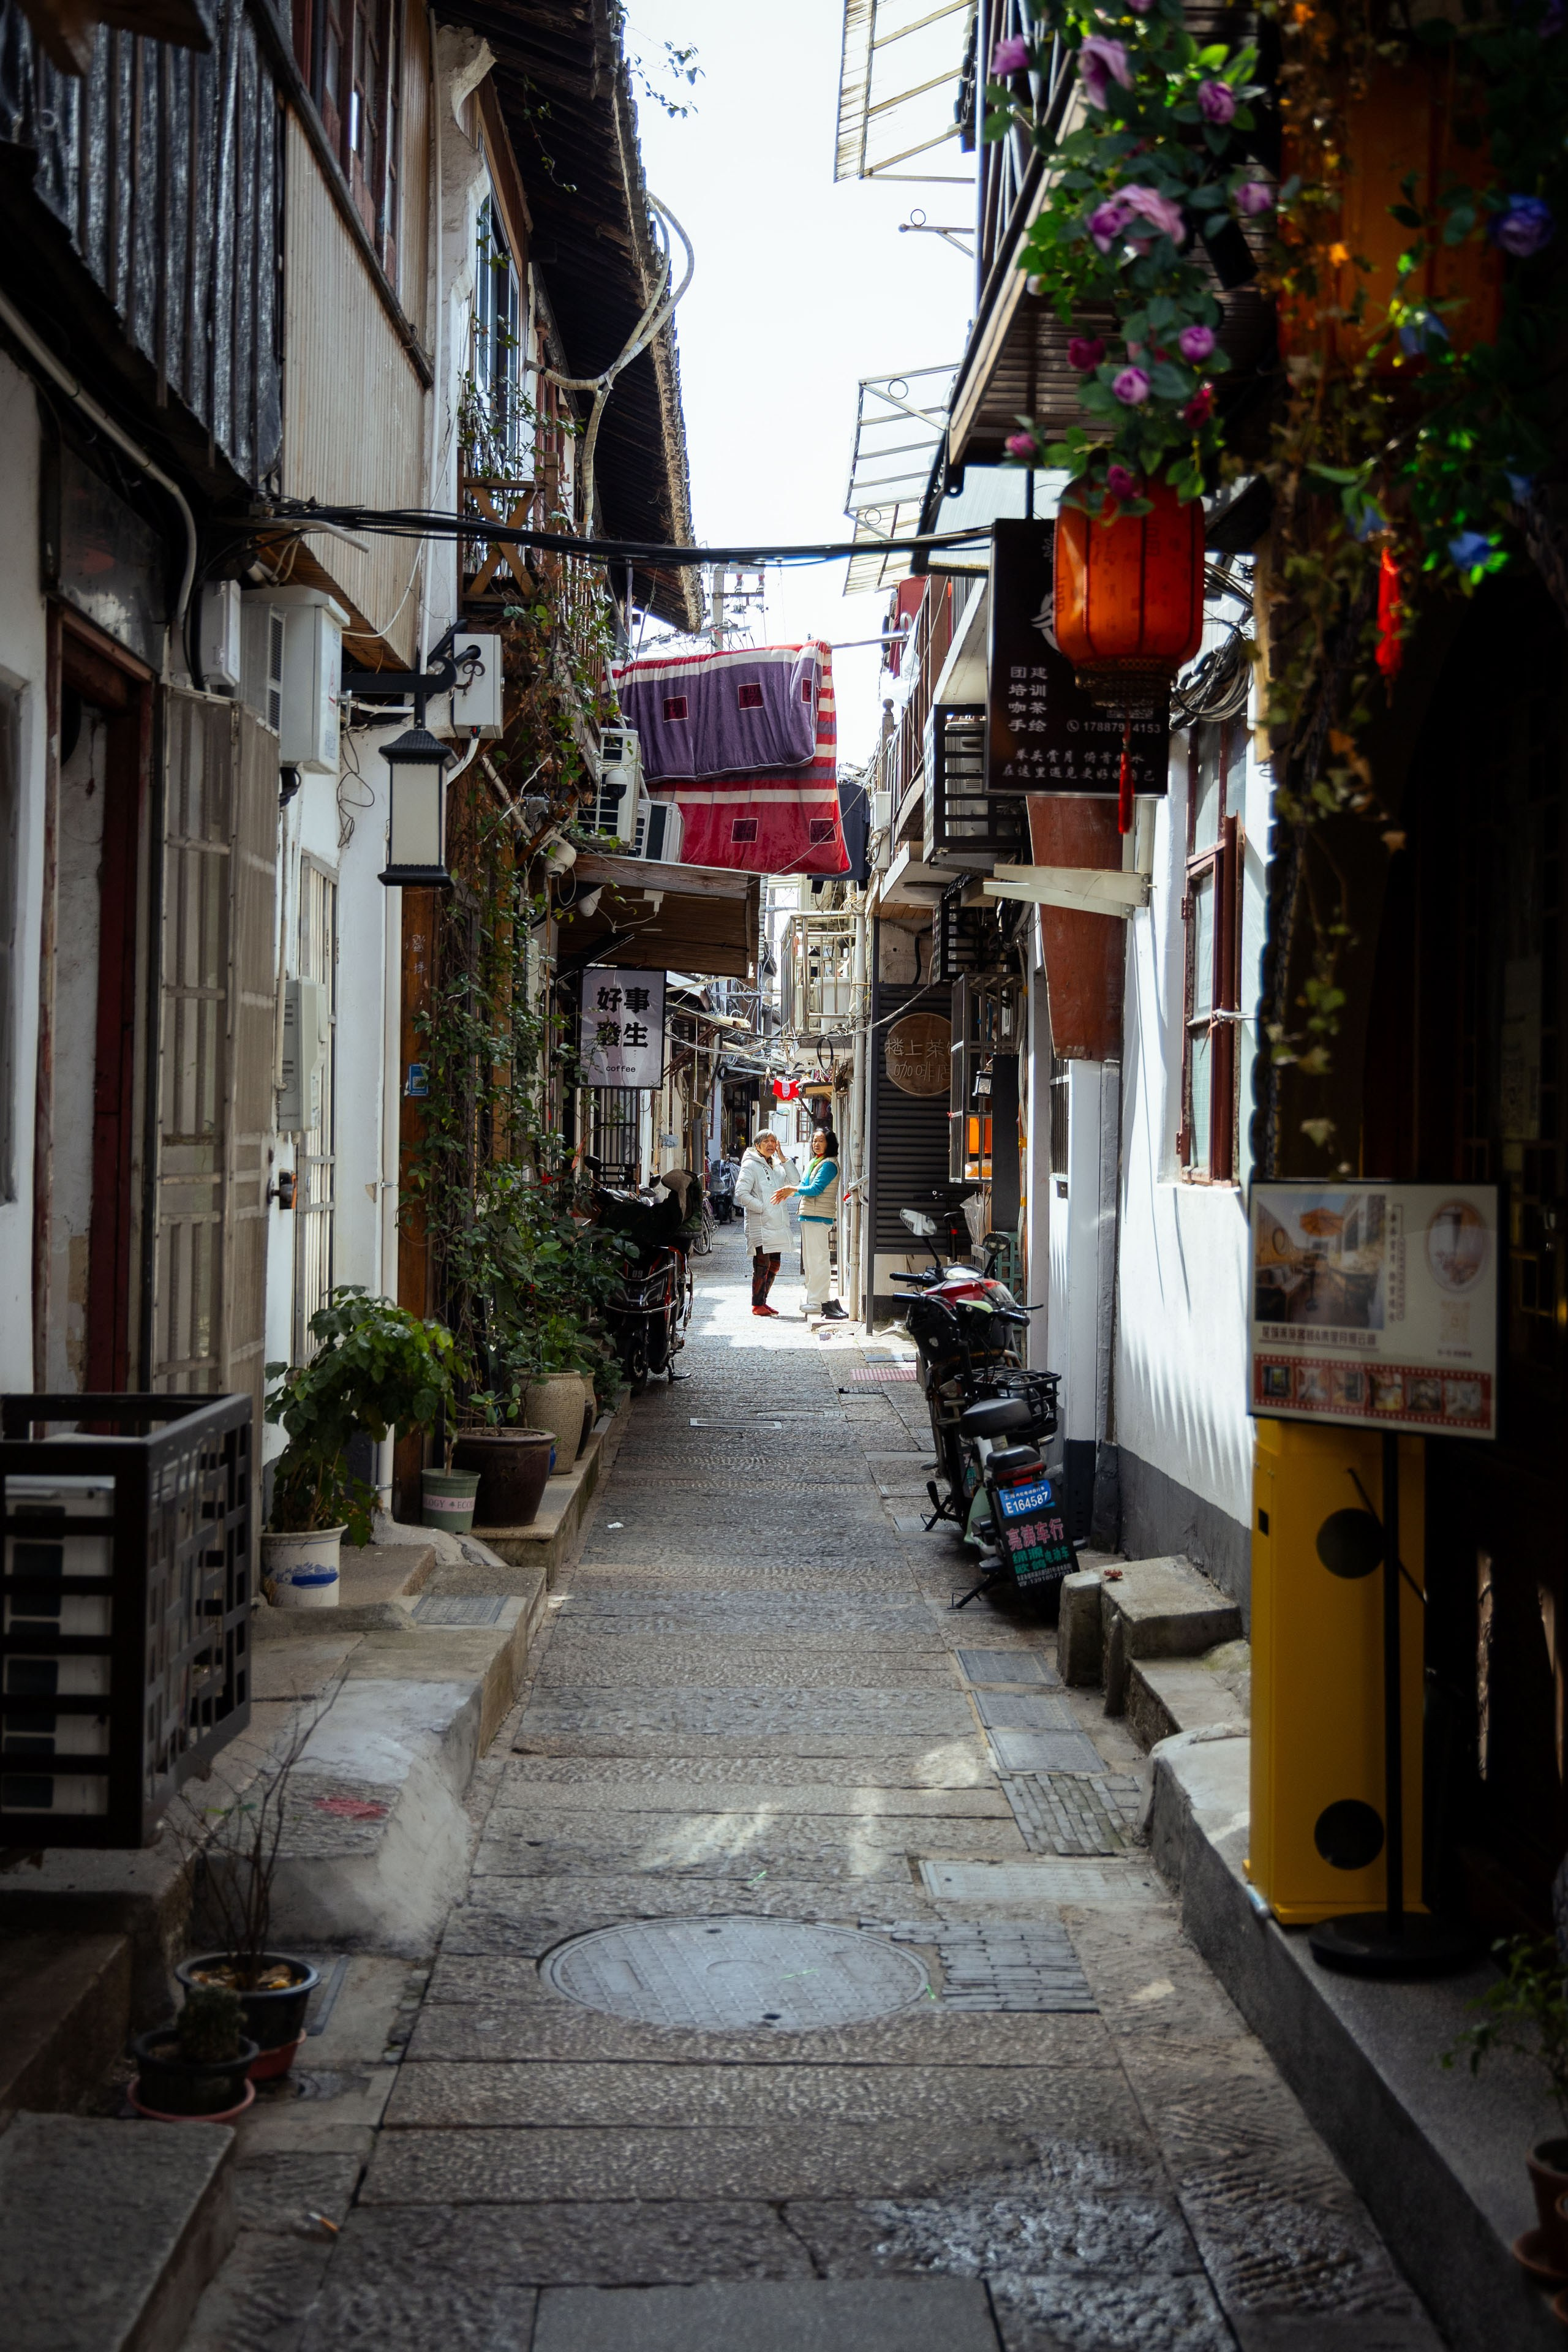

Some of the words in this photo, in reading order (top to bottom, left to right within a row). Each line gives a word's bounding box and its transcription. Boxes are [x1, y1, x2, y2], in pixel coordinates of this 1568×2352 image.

[1010, 666, 1048, 680] 团建
[1008, 684, 1047, 697] 培训
[1008, 702, 1047, 715] 咖茶
[1008, 719, 1047, 733] 手绘
[1084, 722, 1161, 734] 1788794153
[597, 986, 650, 1013] 好事
[1005, 1491, 1049, 1514] E164587
[1012, 1546, 1044, 1562] 绿源
[1044, 1545, 1069, 1563] 电动车
